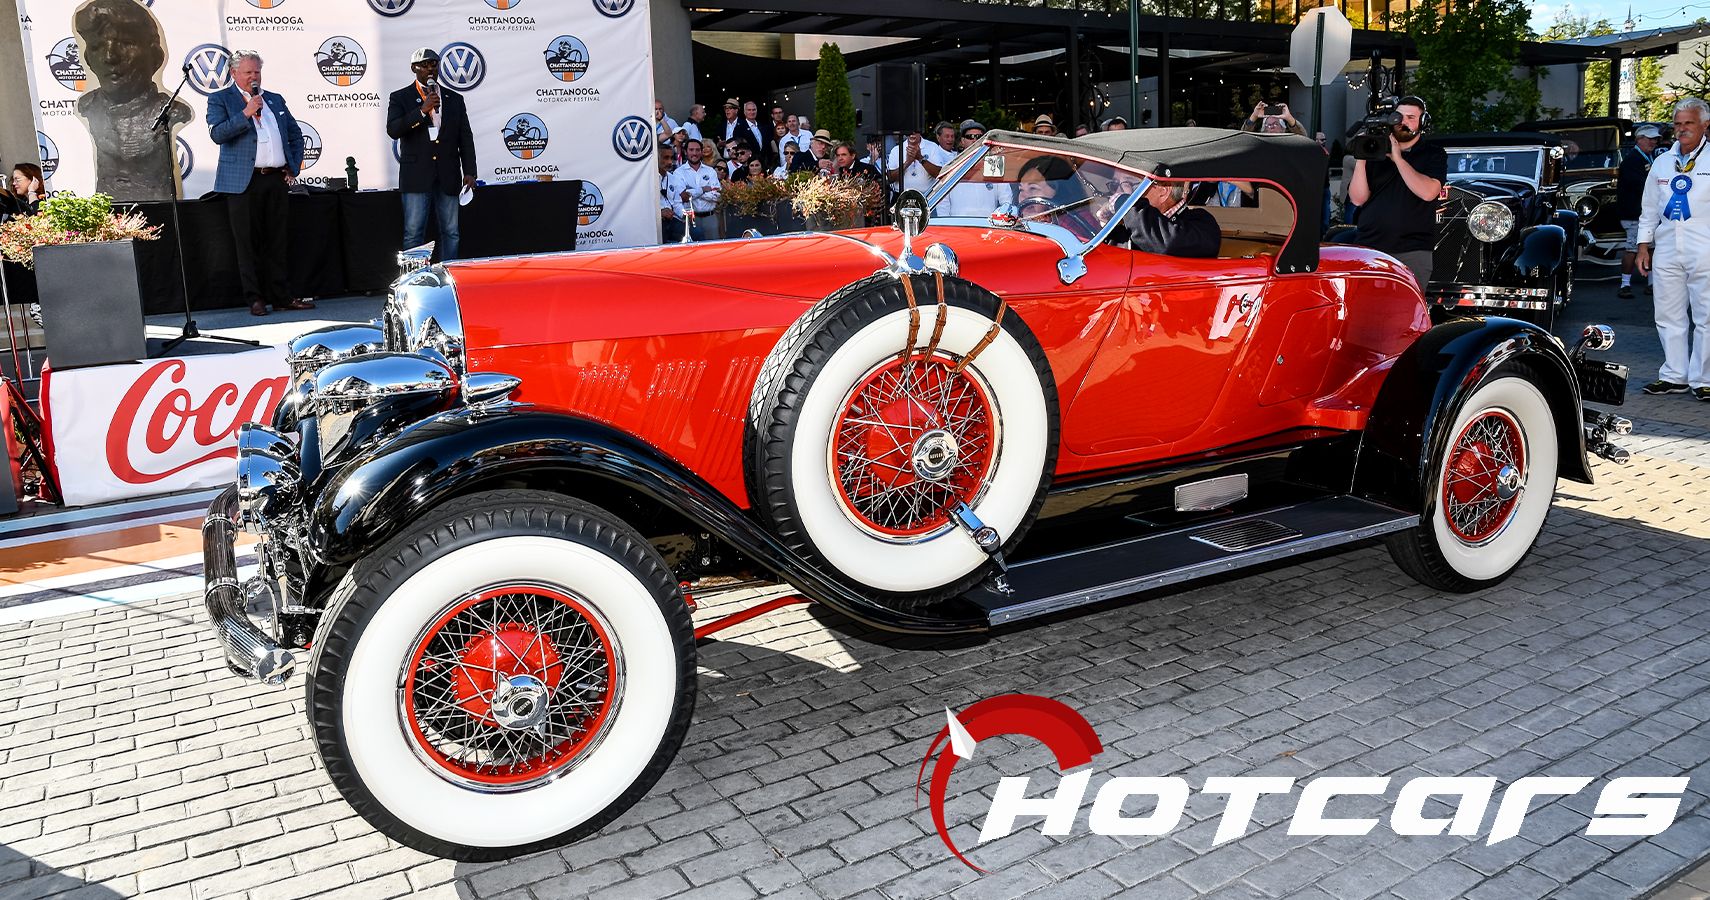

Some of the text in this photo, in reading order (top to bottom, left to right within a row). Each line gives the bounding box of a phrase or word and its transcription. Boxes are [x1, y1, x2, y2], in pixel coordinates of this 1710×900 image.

[226, 16, 304, 25] CHATTANOOGA
[468, 16, 536, 25] CHATTANOOGA
[307, 92, 381, 102] CHATTANOOGA
[536, 87, 600, 97] CHATTANOOGA
[494, 165, 560, 175] CHATTANOOGA
